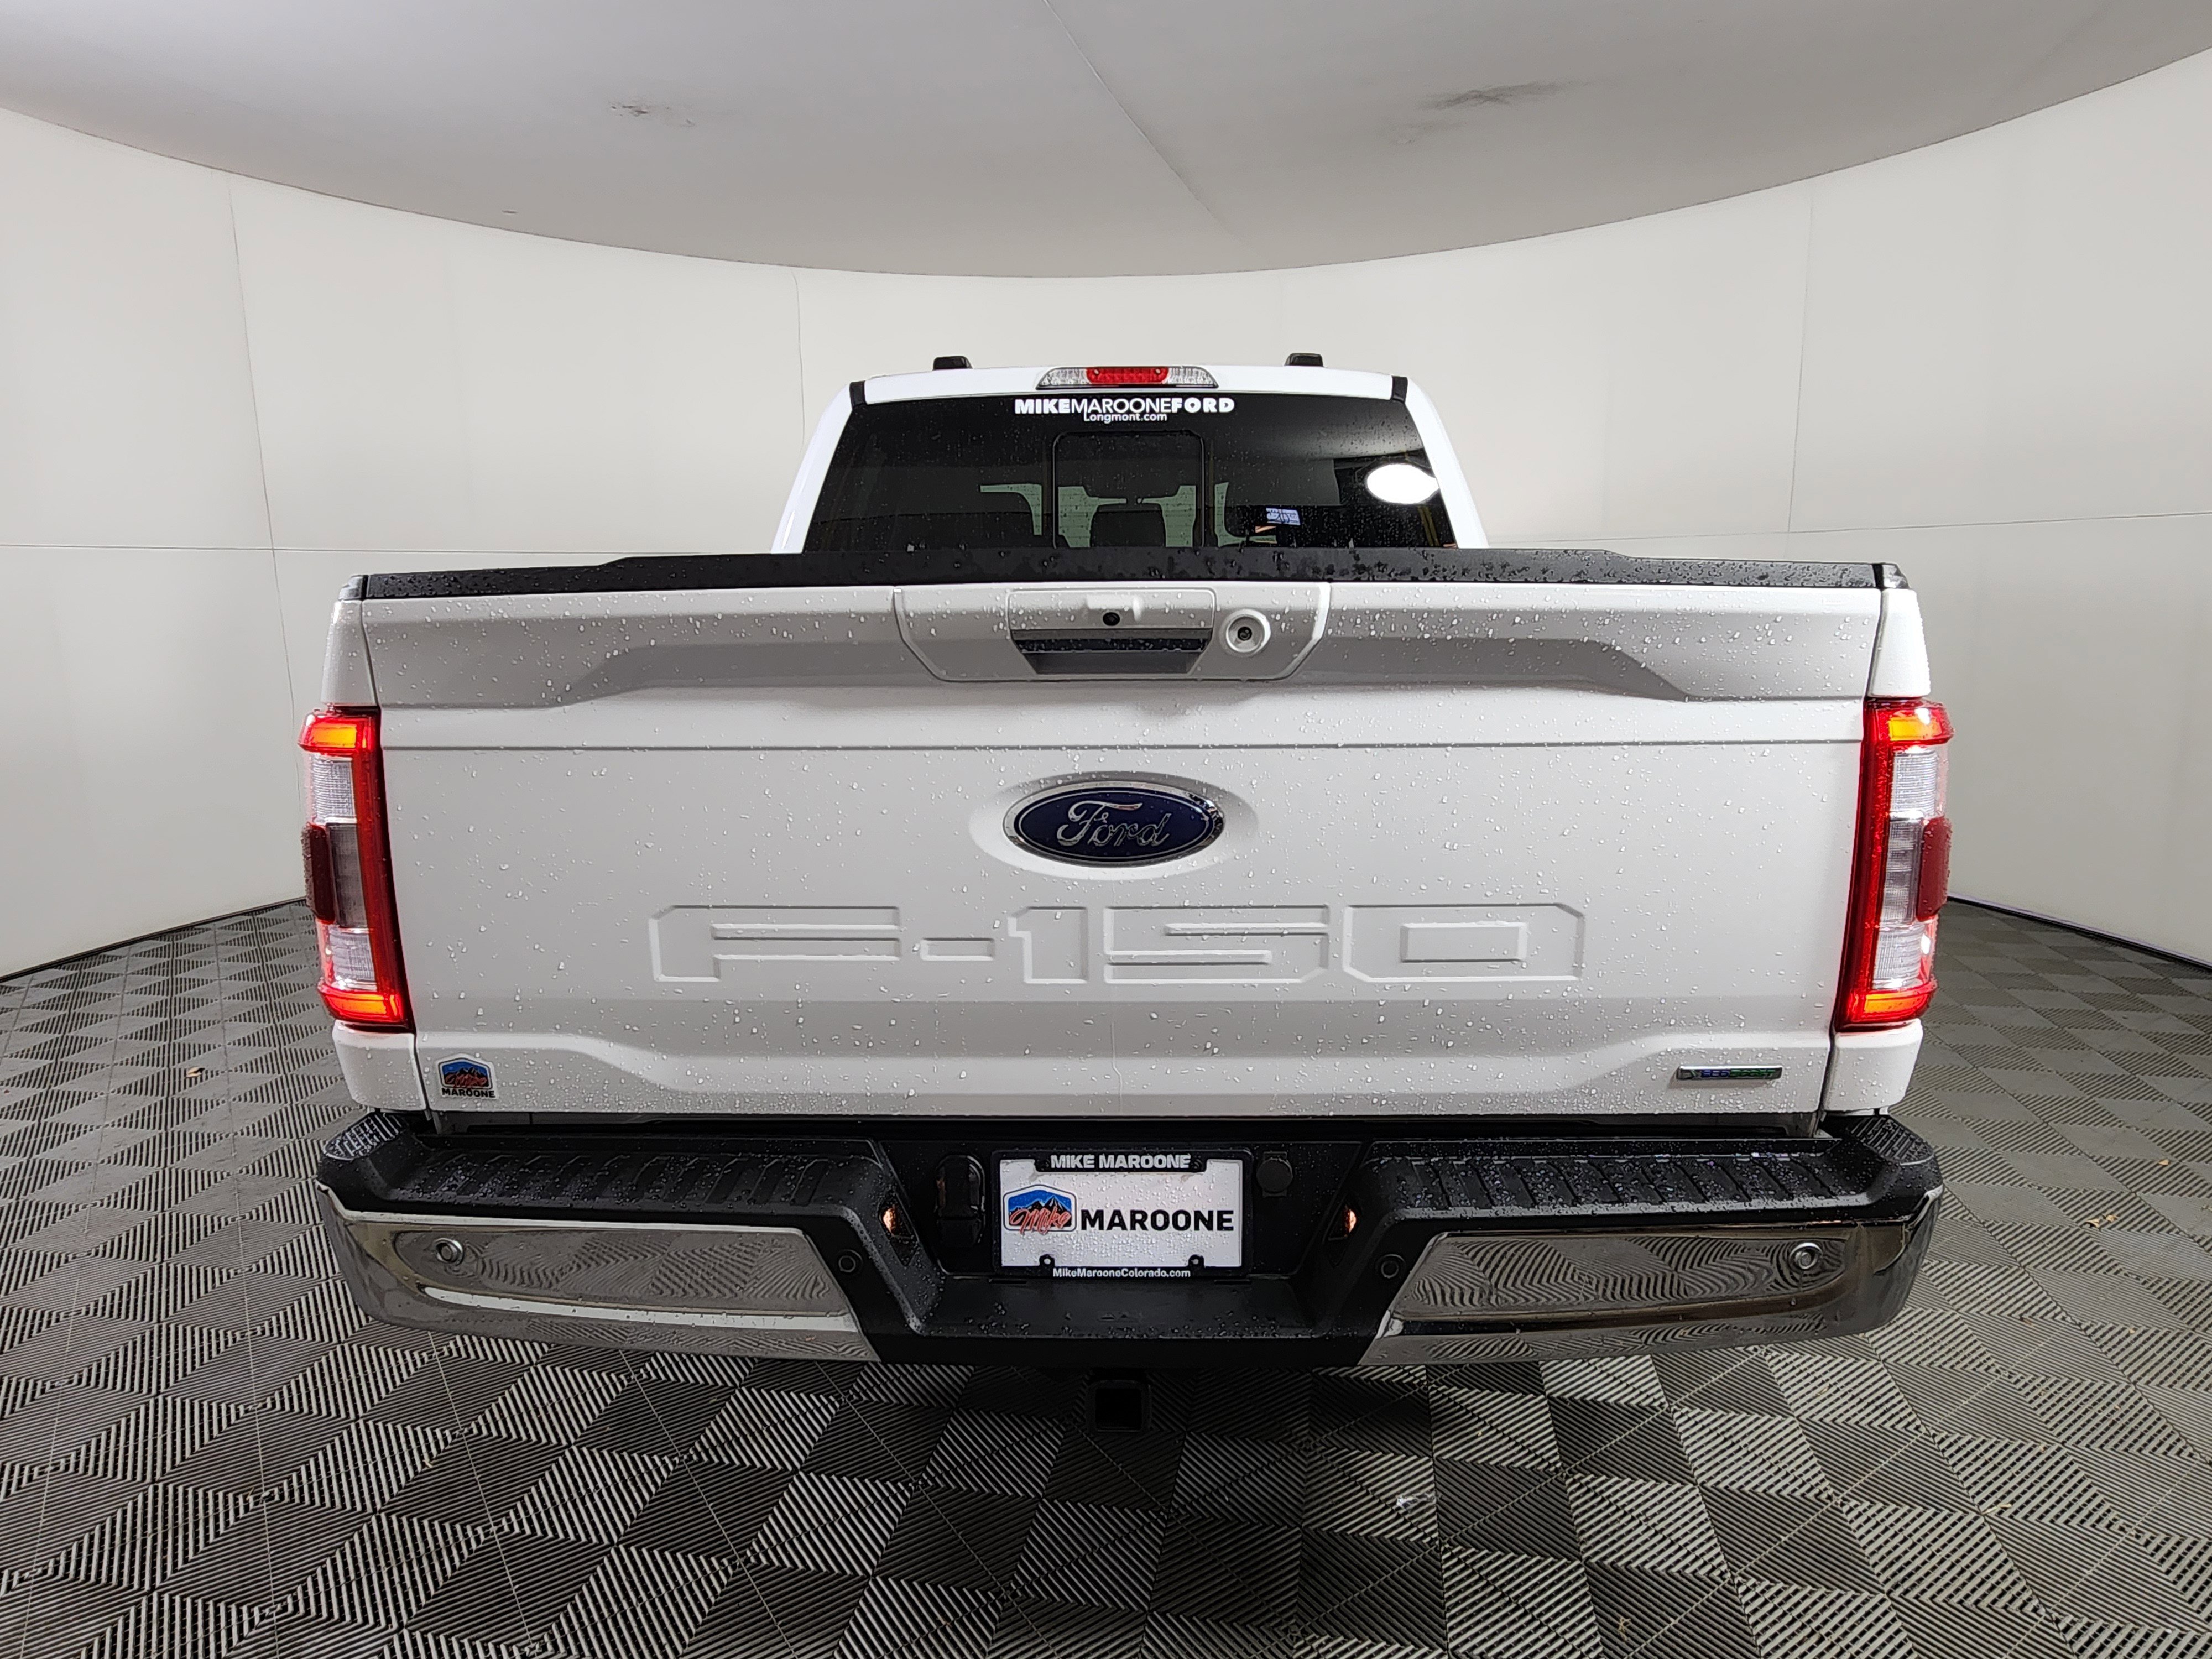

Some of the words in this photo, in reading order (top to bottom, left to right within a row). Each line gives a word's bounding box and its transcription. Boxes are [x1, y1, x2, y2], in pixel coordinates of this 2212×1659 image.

[1083, 412, 1167, 424] Longmont.com
[1057, 800, 1172, 847] Ford
[648, 905, 1586, 983] F-150
[441, 1088, 495, 1098] MAROONE
[1051, 1155, 1095, 1168] MIKE
[1099, 1154, 1191, 1168] MAROONE
[1008, 1206, 1072, 1234] Mike
[1081, 1209, 1234, 1231] MAROONE
[1052, 1268, 1191, 1278] MikeMarooneColorado.com
